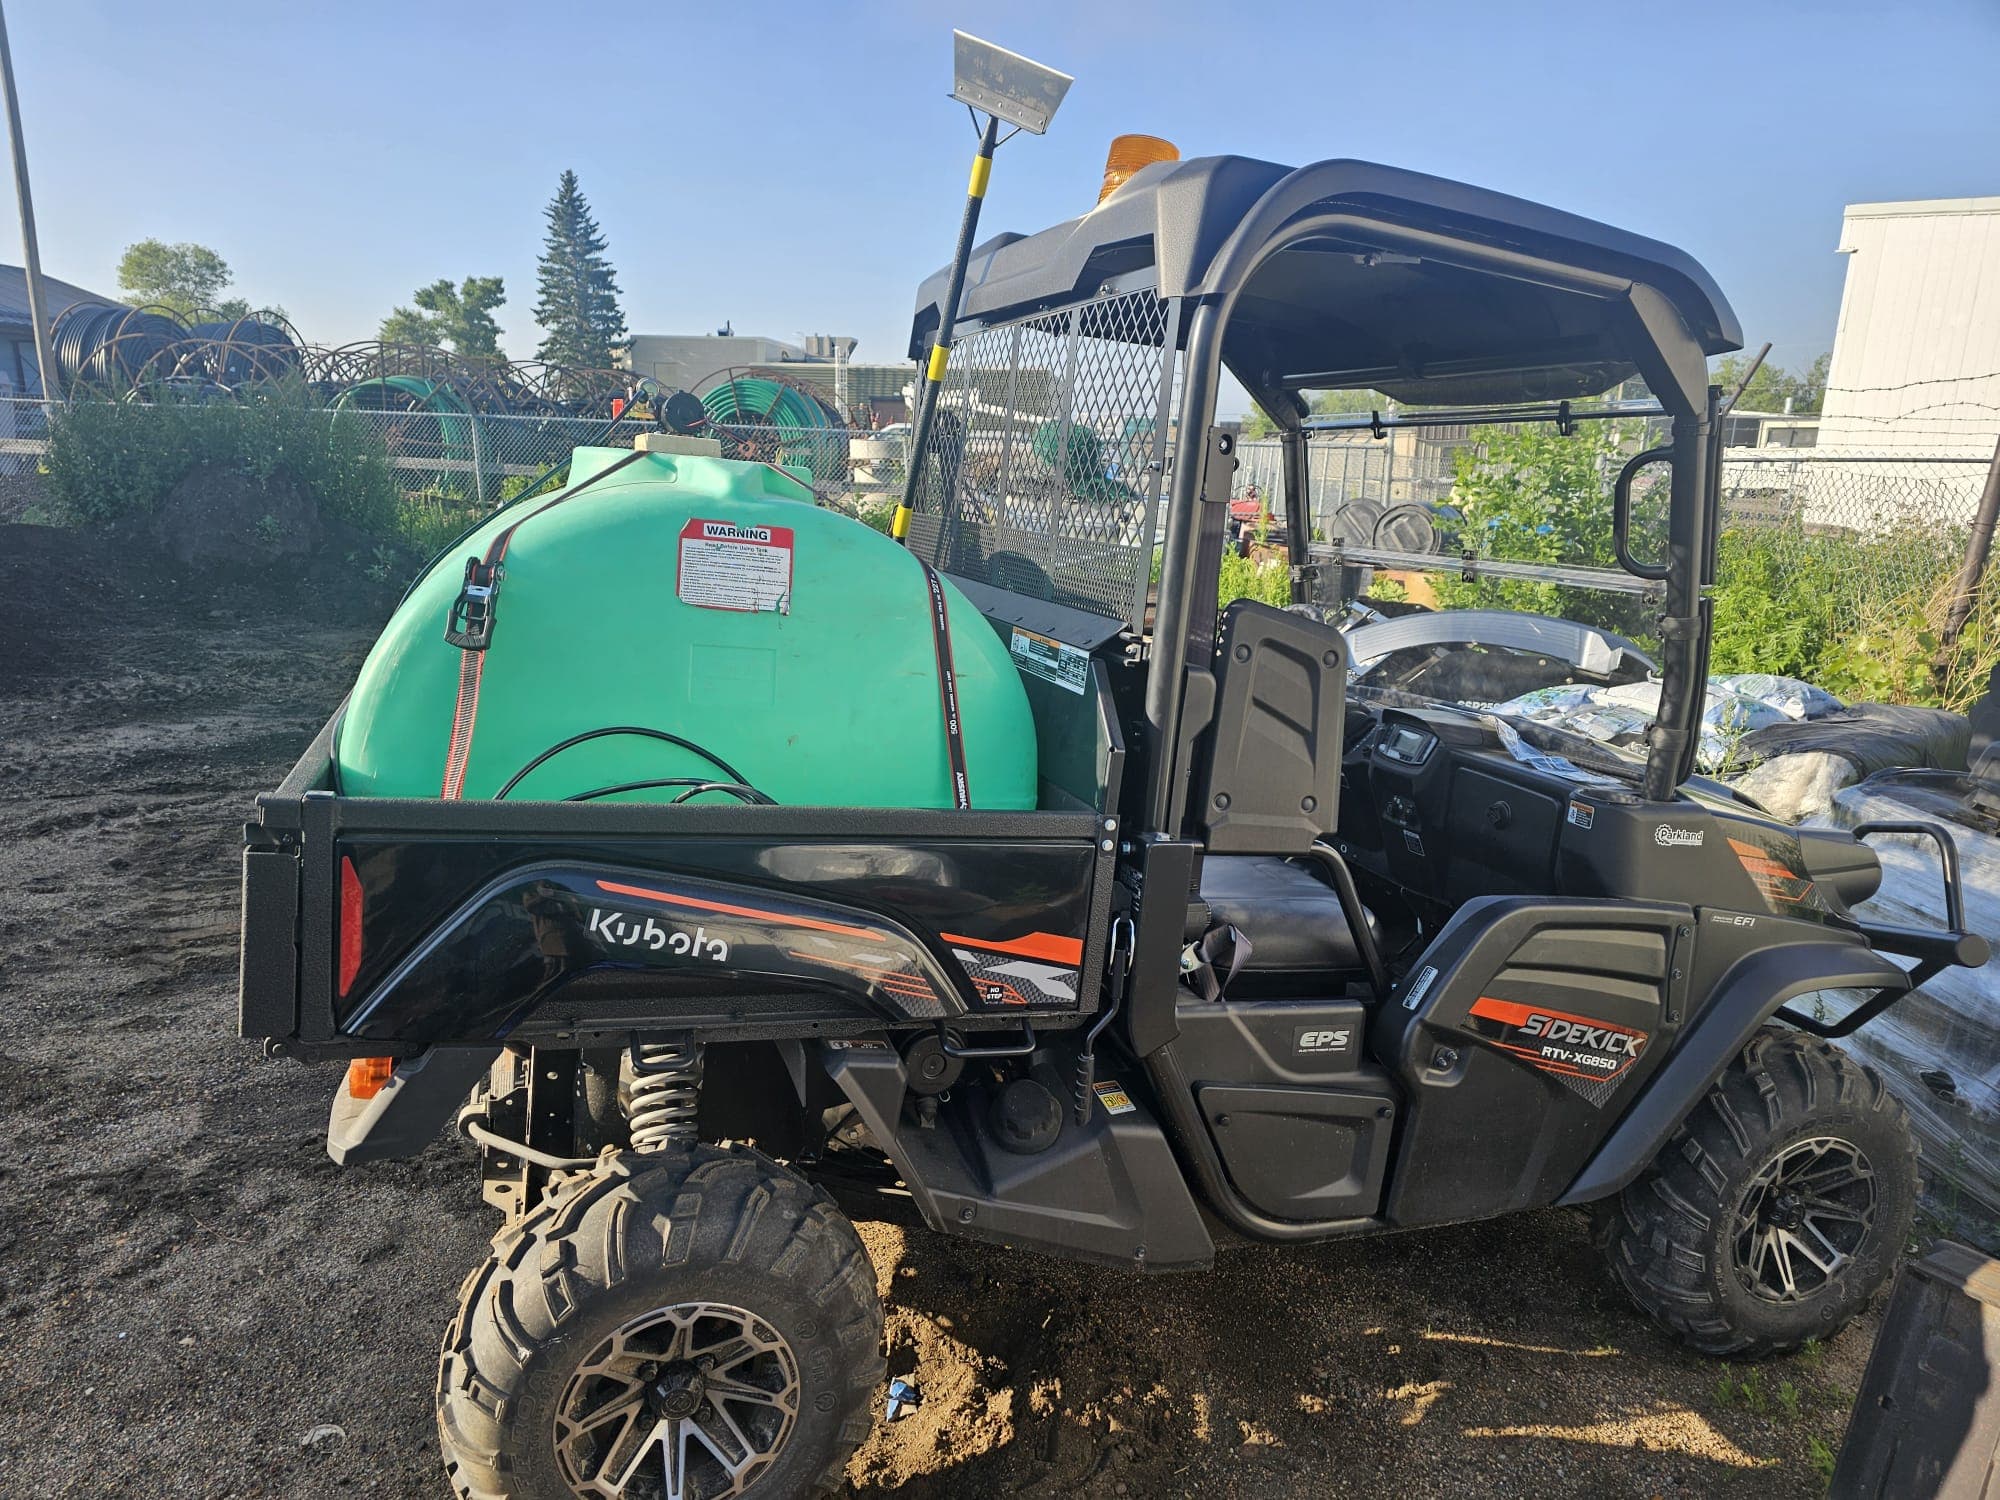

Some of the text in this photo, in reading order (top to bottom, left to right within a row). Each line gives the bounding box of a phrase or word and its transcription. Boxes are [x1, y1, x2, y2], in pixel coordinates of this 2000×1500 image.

[706, 525, 768, 540] WARNING
[739, 544, 755, 552] Using
[949, 719, 958, 735] 500
[1660, 829, 1704, 841] Parkland
[1734, 916, 1756, 927] EFI
[589, 908, 728, 962] Kubota
[1300, 1030, 1350, 1047] EPS
[1517, 1014, 1646, 1057] SIDEKICK
[1541, 1046, 1617, 1070] RTV-XG850
